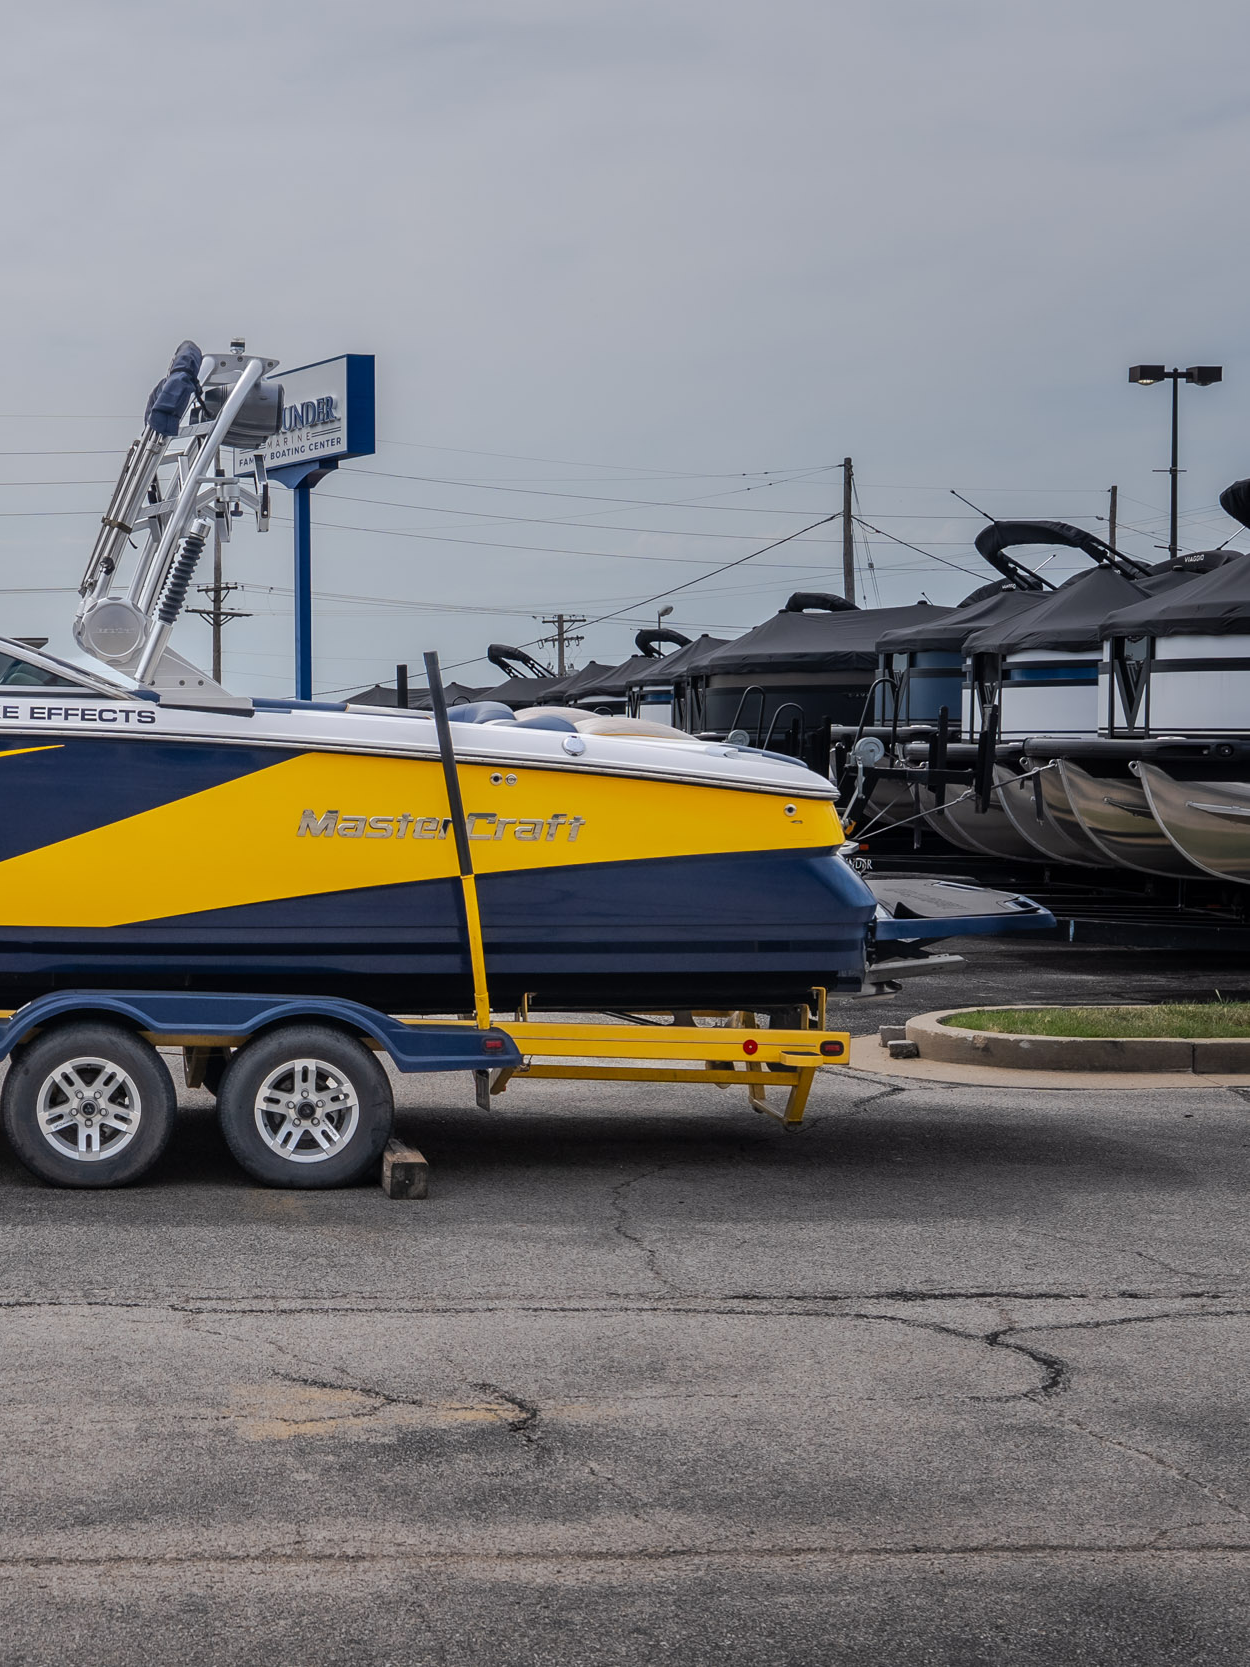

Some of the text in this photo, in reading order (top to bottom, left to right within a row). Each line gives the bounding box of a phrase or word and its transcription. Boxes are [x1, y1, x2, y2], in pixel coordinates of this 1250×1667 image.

[282, 395, 337, 431] UNDER
[239, 436, 342, 467] FAMY BOATING CENTER
[267, 431, 311, 449] MARINE
[29, 706, 156, 724] EFFECTS
